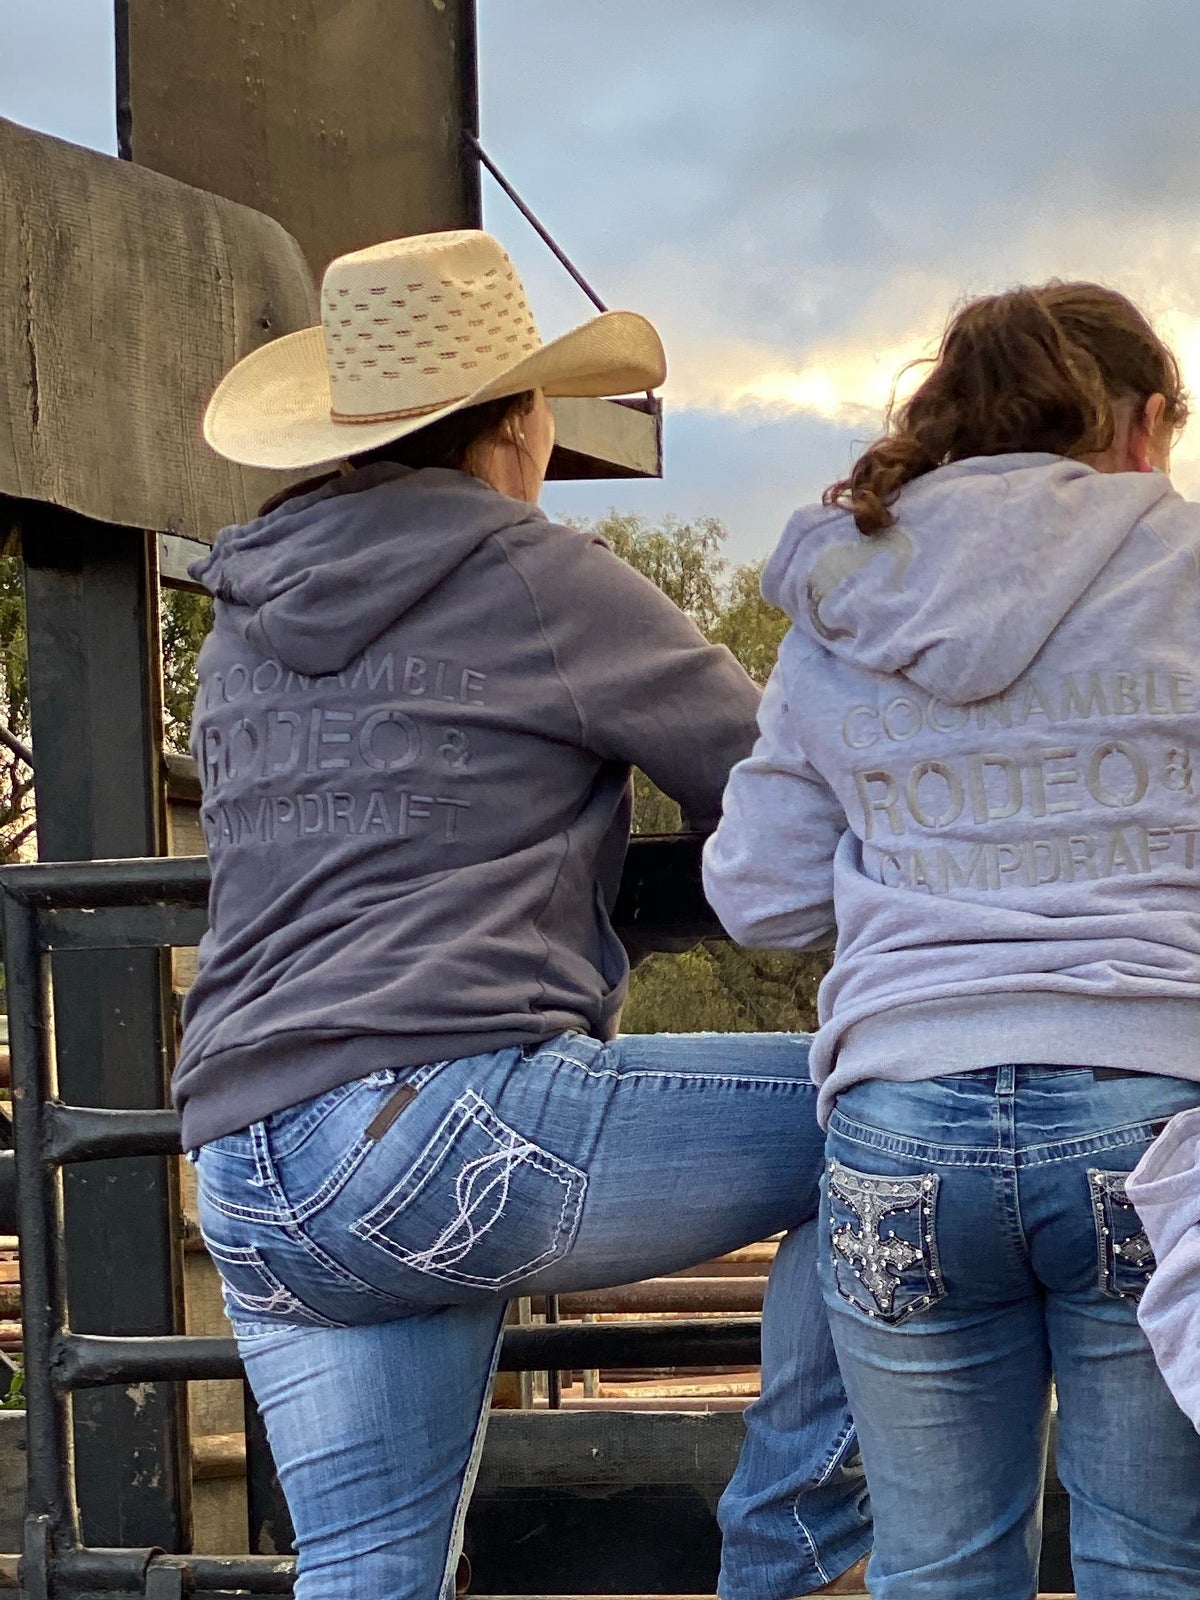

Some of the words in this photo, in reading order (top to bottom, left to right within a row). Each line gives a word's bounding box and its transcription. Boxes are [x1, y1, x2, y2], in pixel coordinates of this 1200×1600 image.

[437, 727, 472, 772] &
[855, 739, 1150, 841] RODEO
[1160, 747, 1195, 796] &
